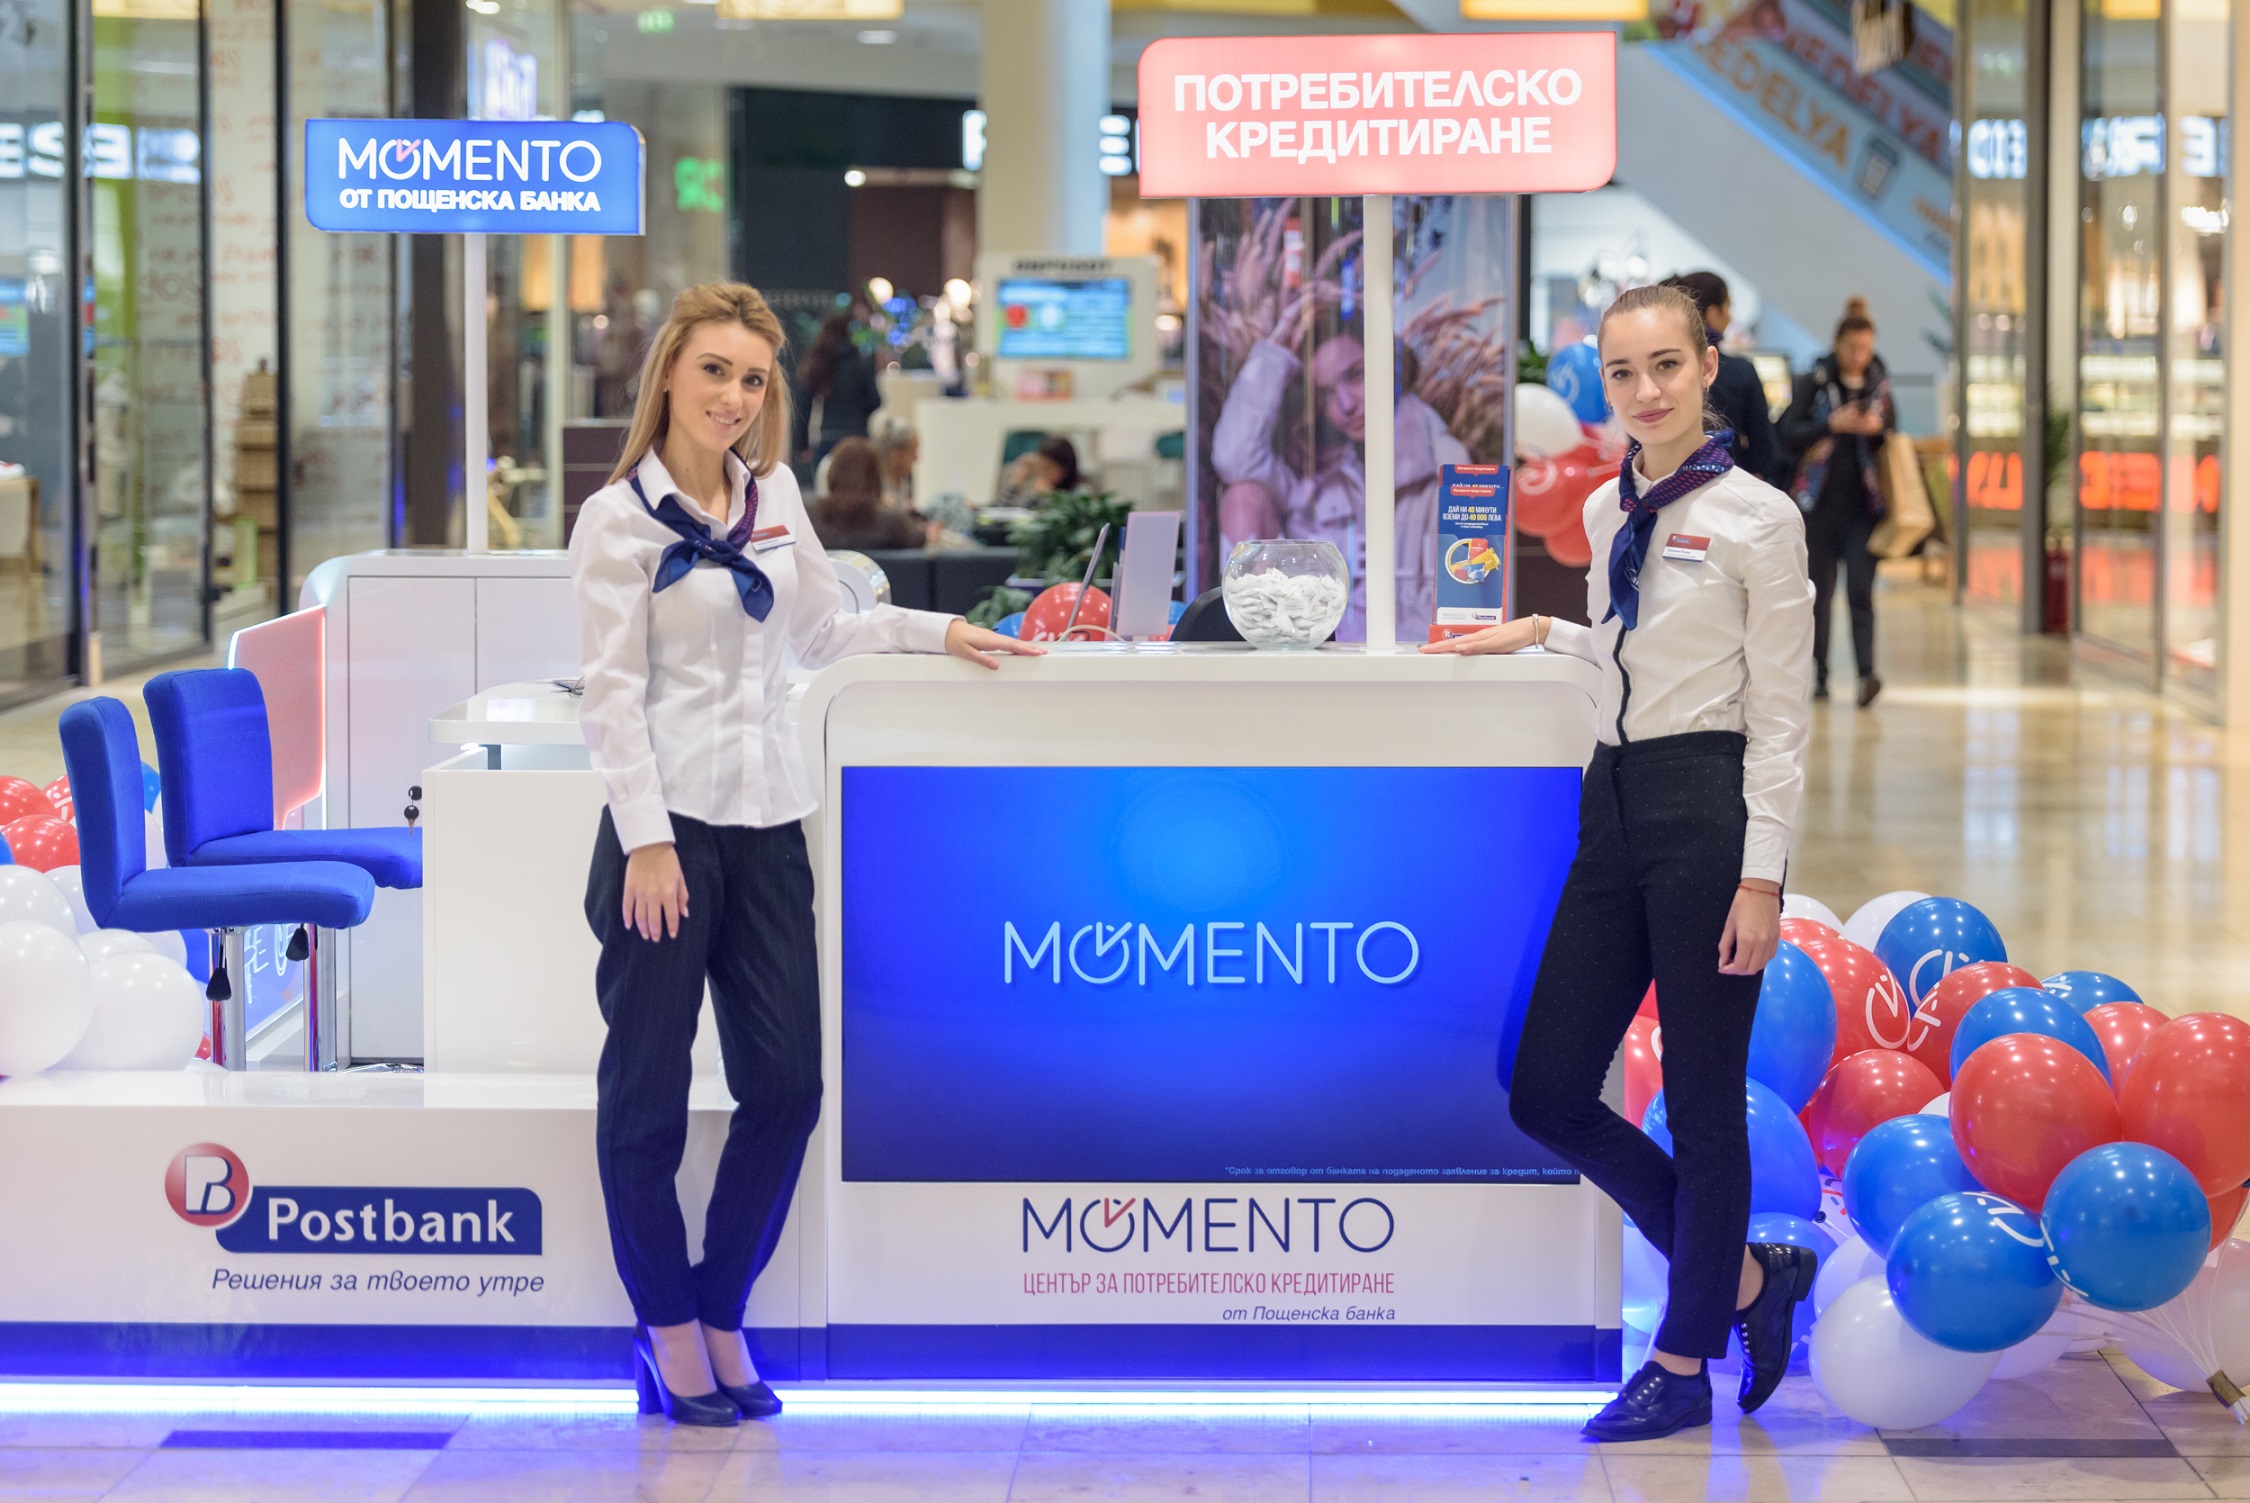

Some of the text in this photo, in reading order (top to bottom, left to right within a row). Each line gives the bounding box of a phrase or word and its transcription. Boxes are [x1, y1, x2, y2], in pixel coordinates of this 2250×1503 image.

[1174, 69, 1582, 111] ПОТРЕБИТЕЛСКО
[338, 138, 602, 182] MOMENTO
[1206, 116, 1552, 164] КРЕДИТИРАНЕ
[339, 188, 601, 212] ОТ ПОЩЕНСКА БАНКА
[1004, 921, 1419, 985] MOMENTO
[1266, 1167, 1307, 1176] отговор
[1326, 1167, 1366, 1175] банката
[1382, 1168, 1439, 1176] подаденото
[1441, 1167, 1487, 1175] заявление
[1542, 1167, 1572, 1175] който
[268, 1197, 516, 1243] Postbank
[1022, 1197, 1395, 1253] MOMENTO
[212, 1269, 544, 1297] Решения за твоето утре
[1023, 1272, 1395, 1296] ЦЕНТЪР ЗА ПОТРЕБИТЕЛСКО КРЕДИТИРАНЕ
[1222, 1305, 1396, 1322] от Пощенска банка
